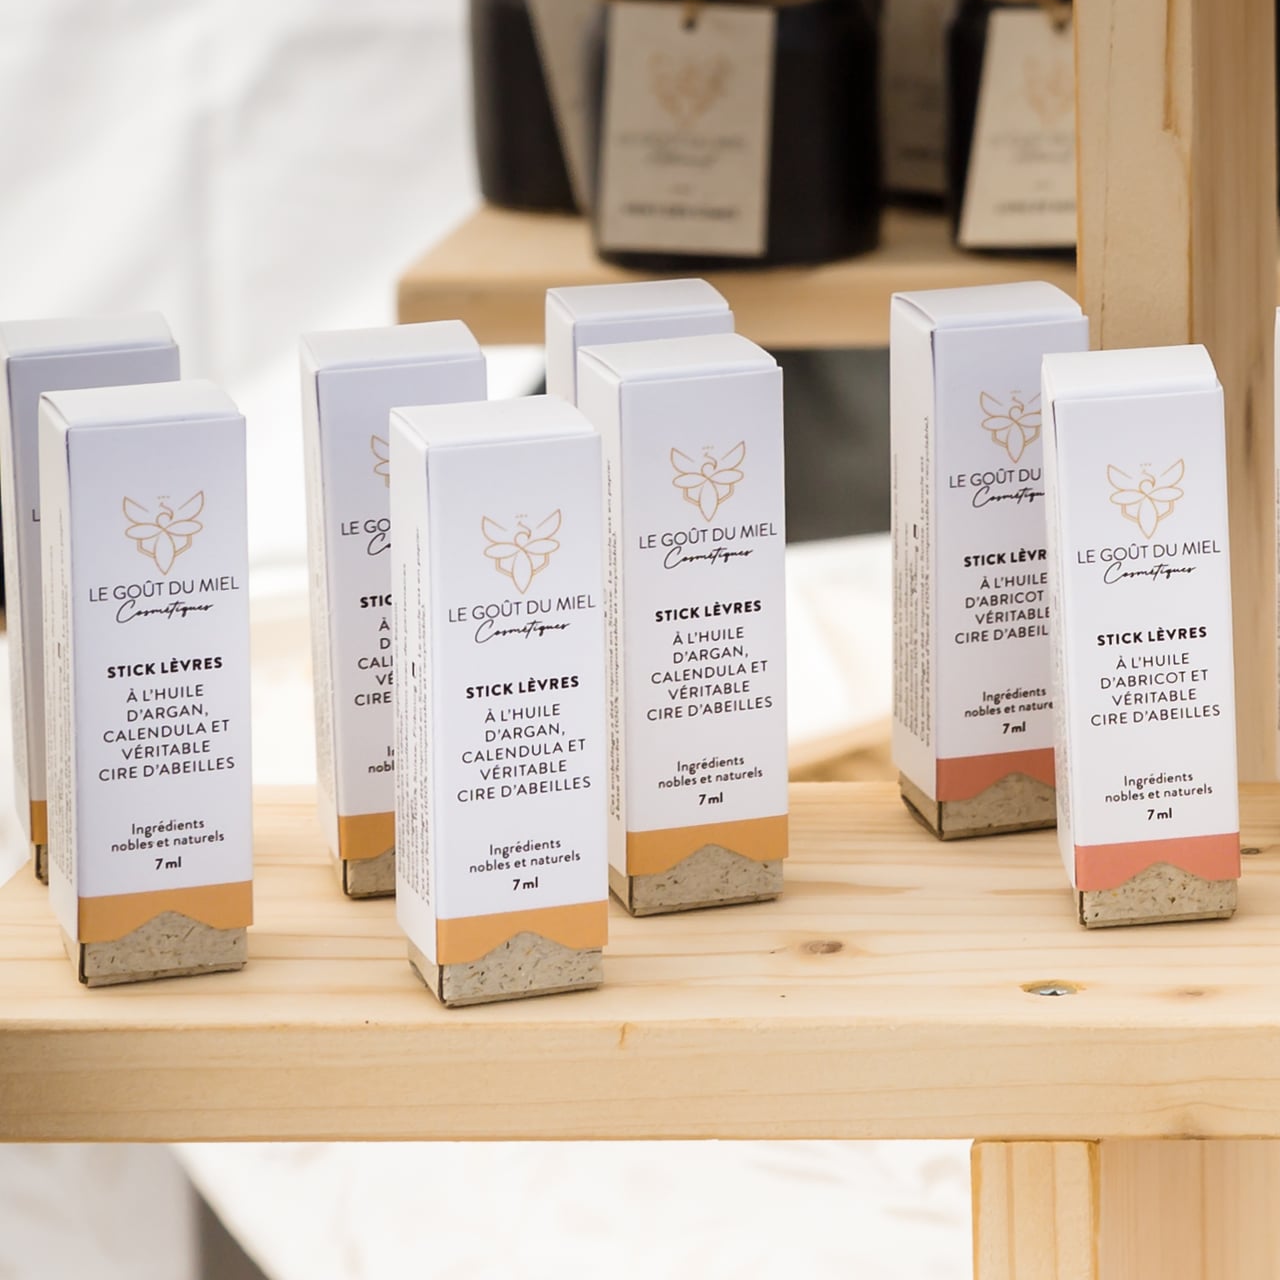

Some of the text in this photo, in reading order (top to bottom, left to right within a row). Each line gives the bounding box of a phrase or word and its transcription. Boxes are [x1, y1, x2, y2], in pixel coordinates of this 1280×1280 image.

[448, 594, 596, 623] LE GOÛT DU MIEL
[474, 619, 570, 644] Cosmétiques
[465, 674, 579, 700] STICK LÈVRES
[484, 702, 560, 724] À L'HUILE
[484, 722, 565, 743] D'ARGAN,
[461, 737, 586, 764] CALENDULA ET
[479, 758, 567, 781] VÉRITABLE
[456, 775, 591, 803] CIRE D'ABEILLES
[469, 849, 581, 873] nobles et naturels
[489, 839, 561, 861] Ingrédients
[512, 875, 539, 891] 7 ml
